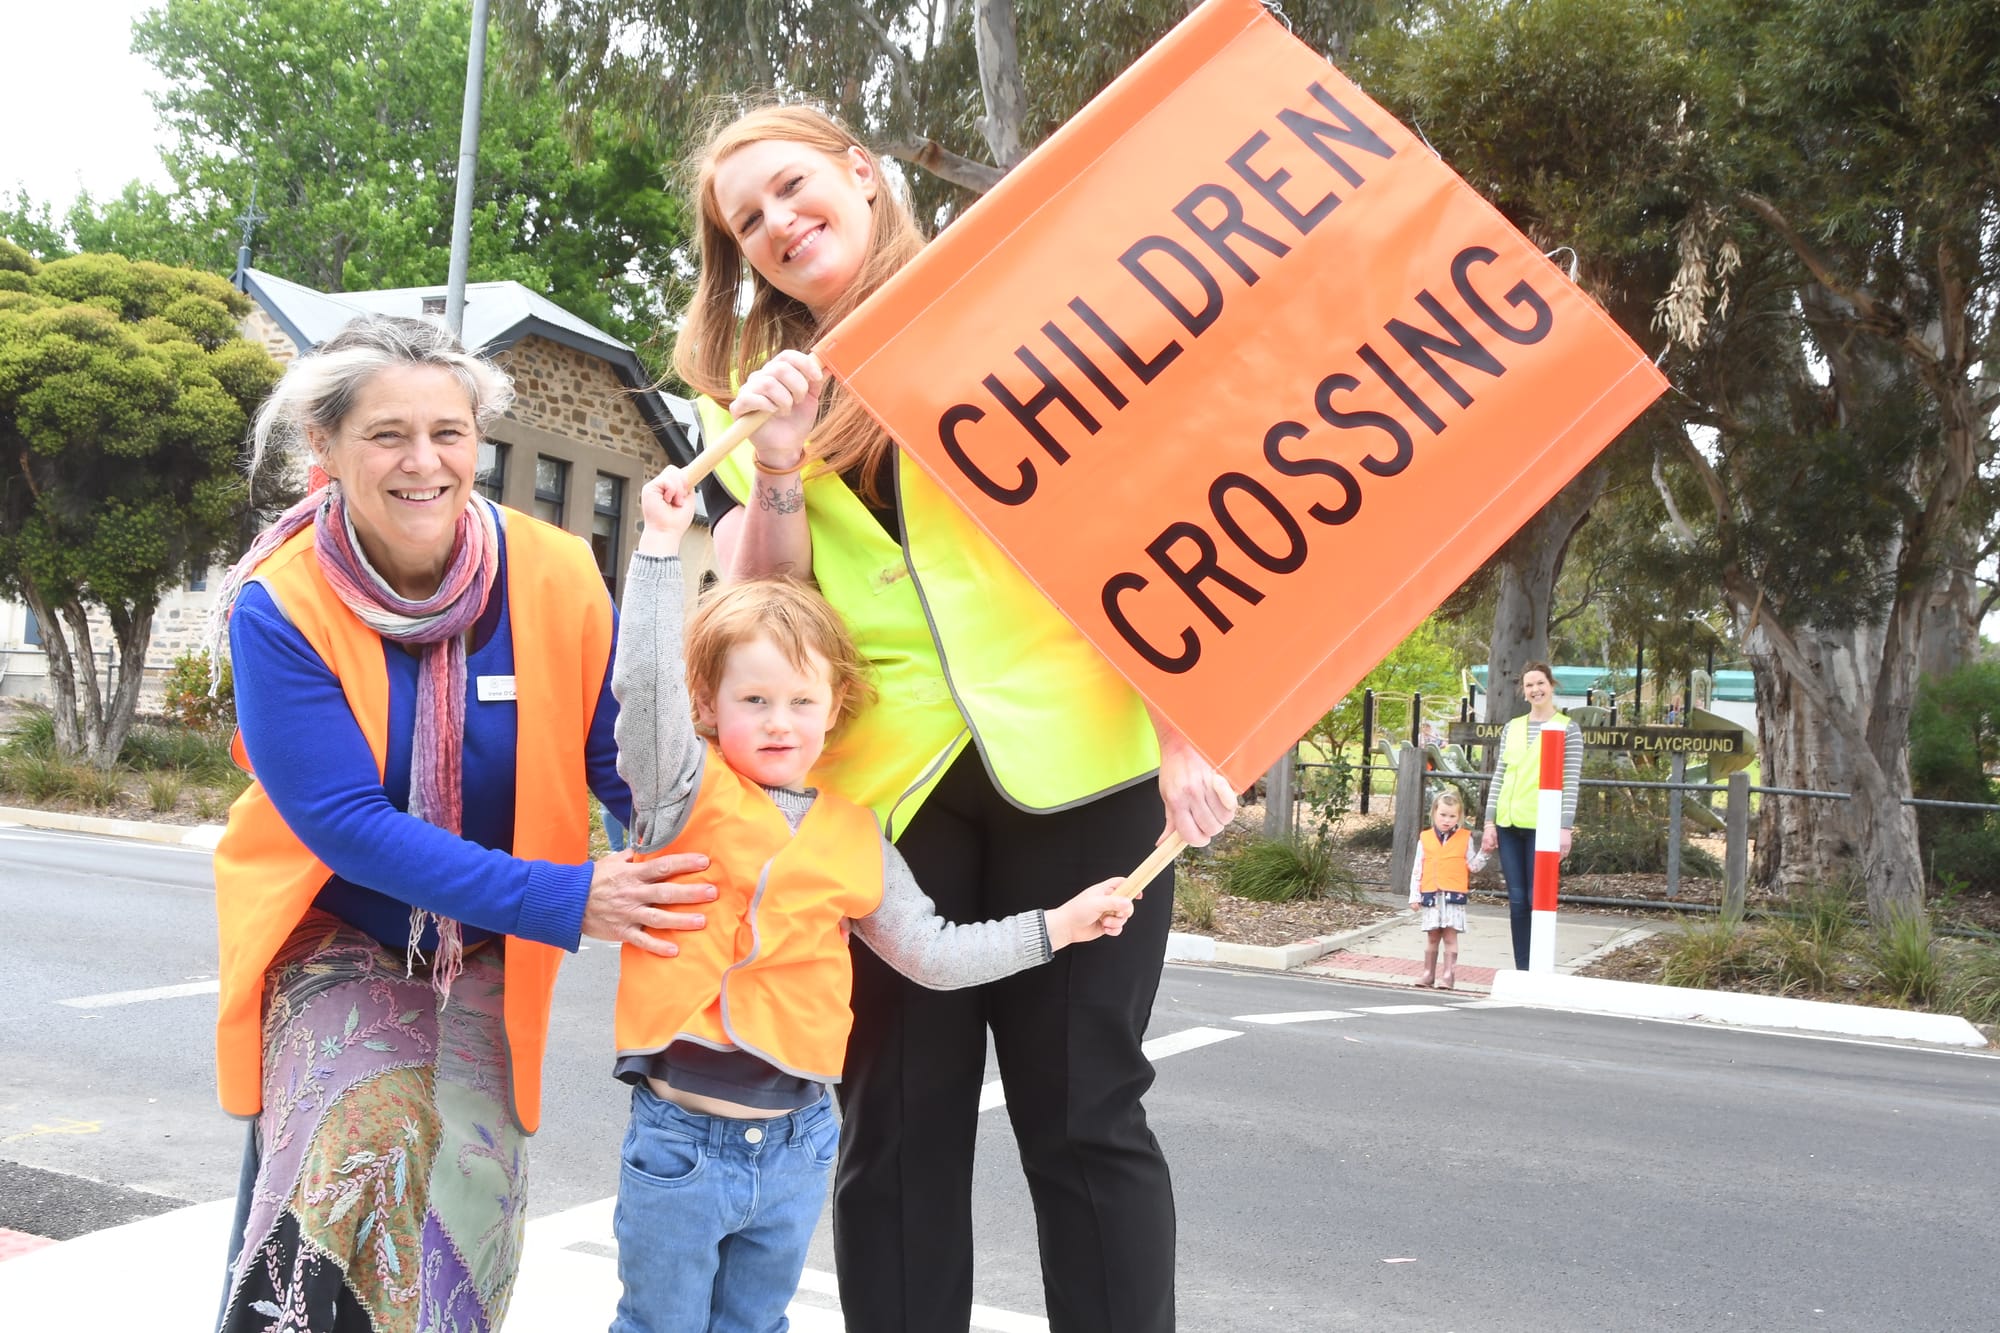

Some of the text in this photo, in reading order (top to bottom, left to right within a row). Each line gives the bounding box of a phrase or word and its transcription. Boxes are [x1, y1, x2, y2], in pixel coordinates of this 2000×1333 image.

[938, 82, 1396, 506] CHILDREN
[1101, 246, 1553, 674] CROSSING
[1634, 735, 1734, 753] PLAYGROUND
